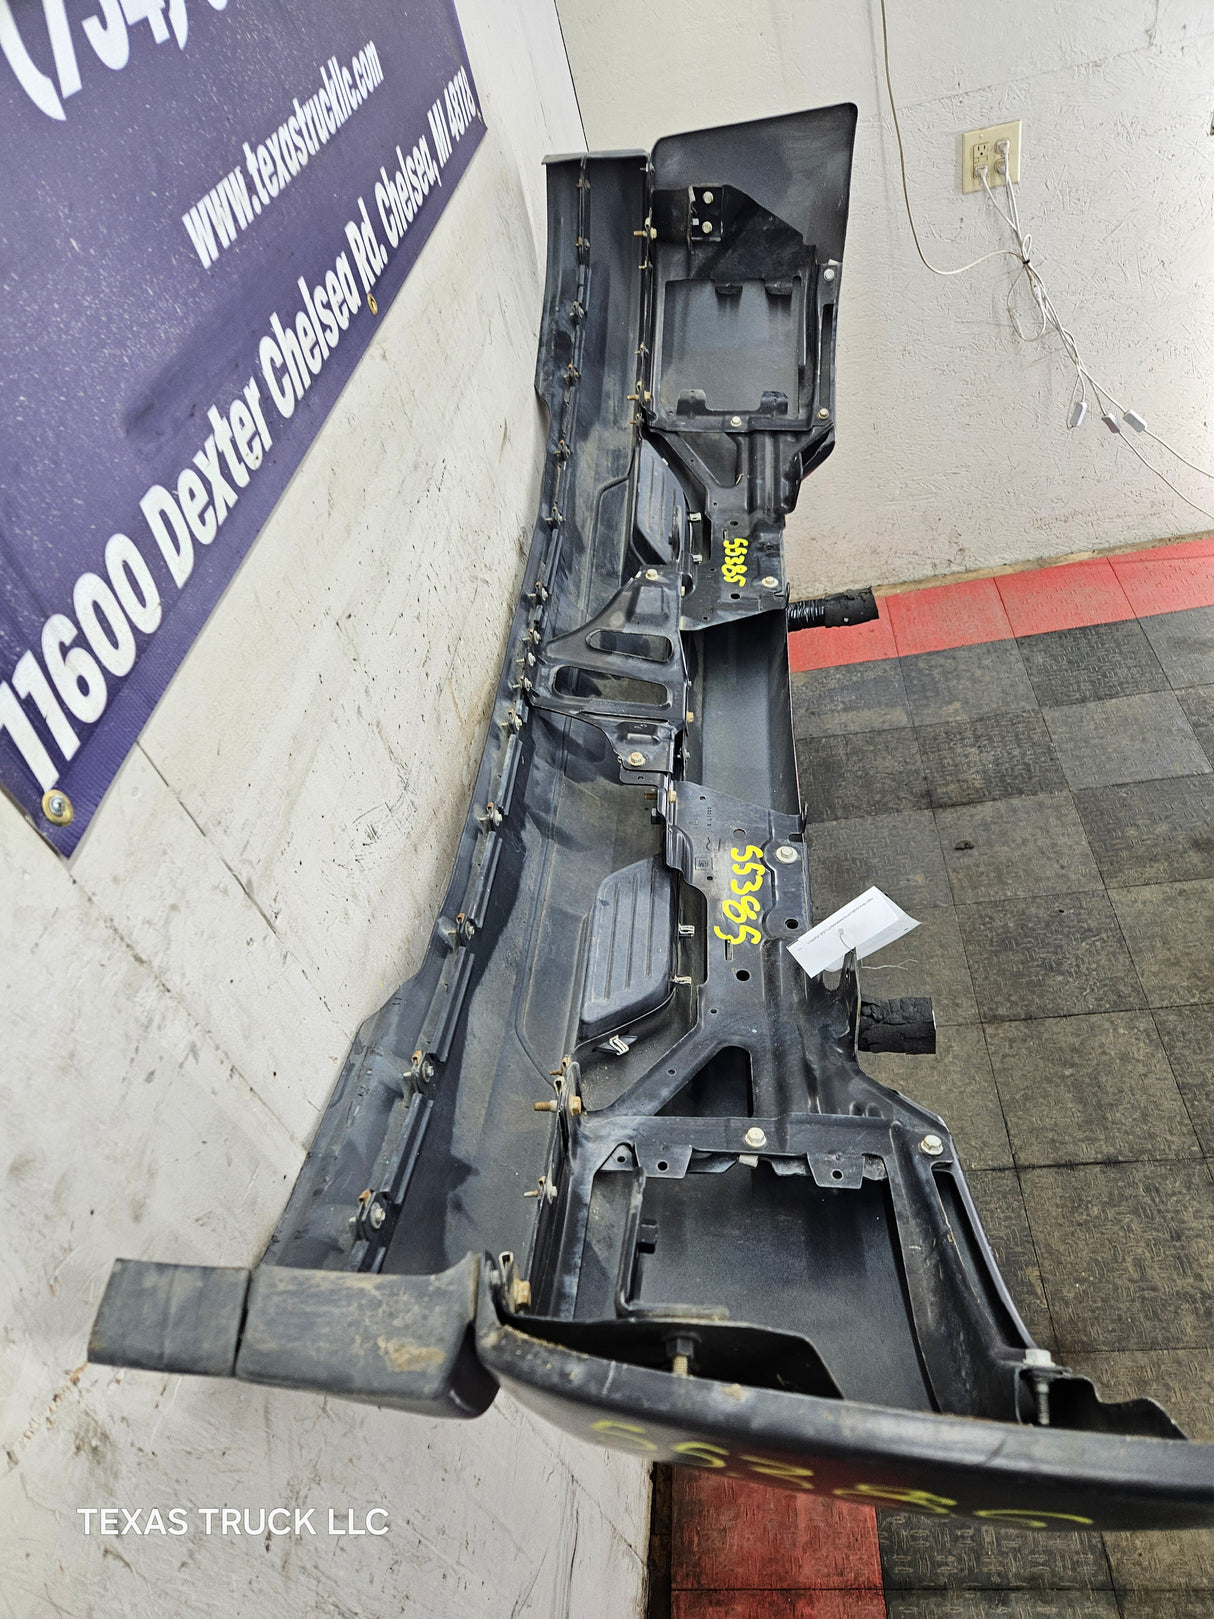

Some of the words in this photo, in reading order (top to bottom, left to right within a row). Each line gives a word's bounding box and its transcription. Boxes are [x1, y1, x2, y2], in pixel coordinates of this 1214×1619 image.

[182, 40, 384, 269] www.texastruckllc.com
[0, 533, 162, 793] 11600
[139, 376, 272, 589] Dexter
[258, 276, 362, 418] Chelsea
[344, 197, 388, 294] Rd.
[374, 134, 442, 249] Chelsea,
[427, 98, 453, 168] MI
[721, 538, 748, 586] 55385
[714, 845, 765, 945] 55385
